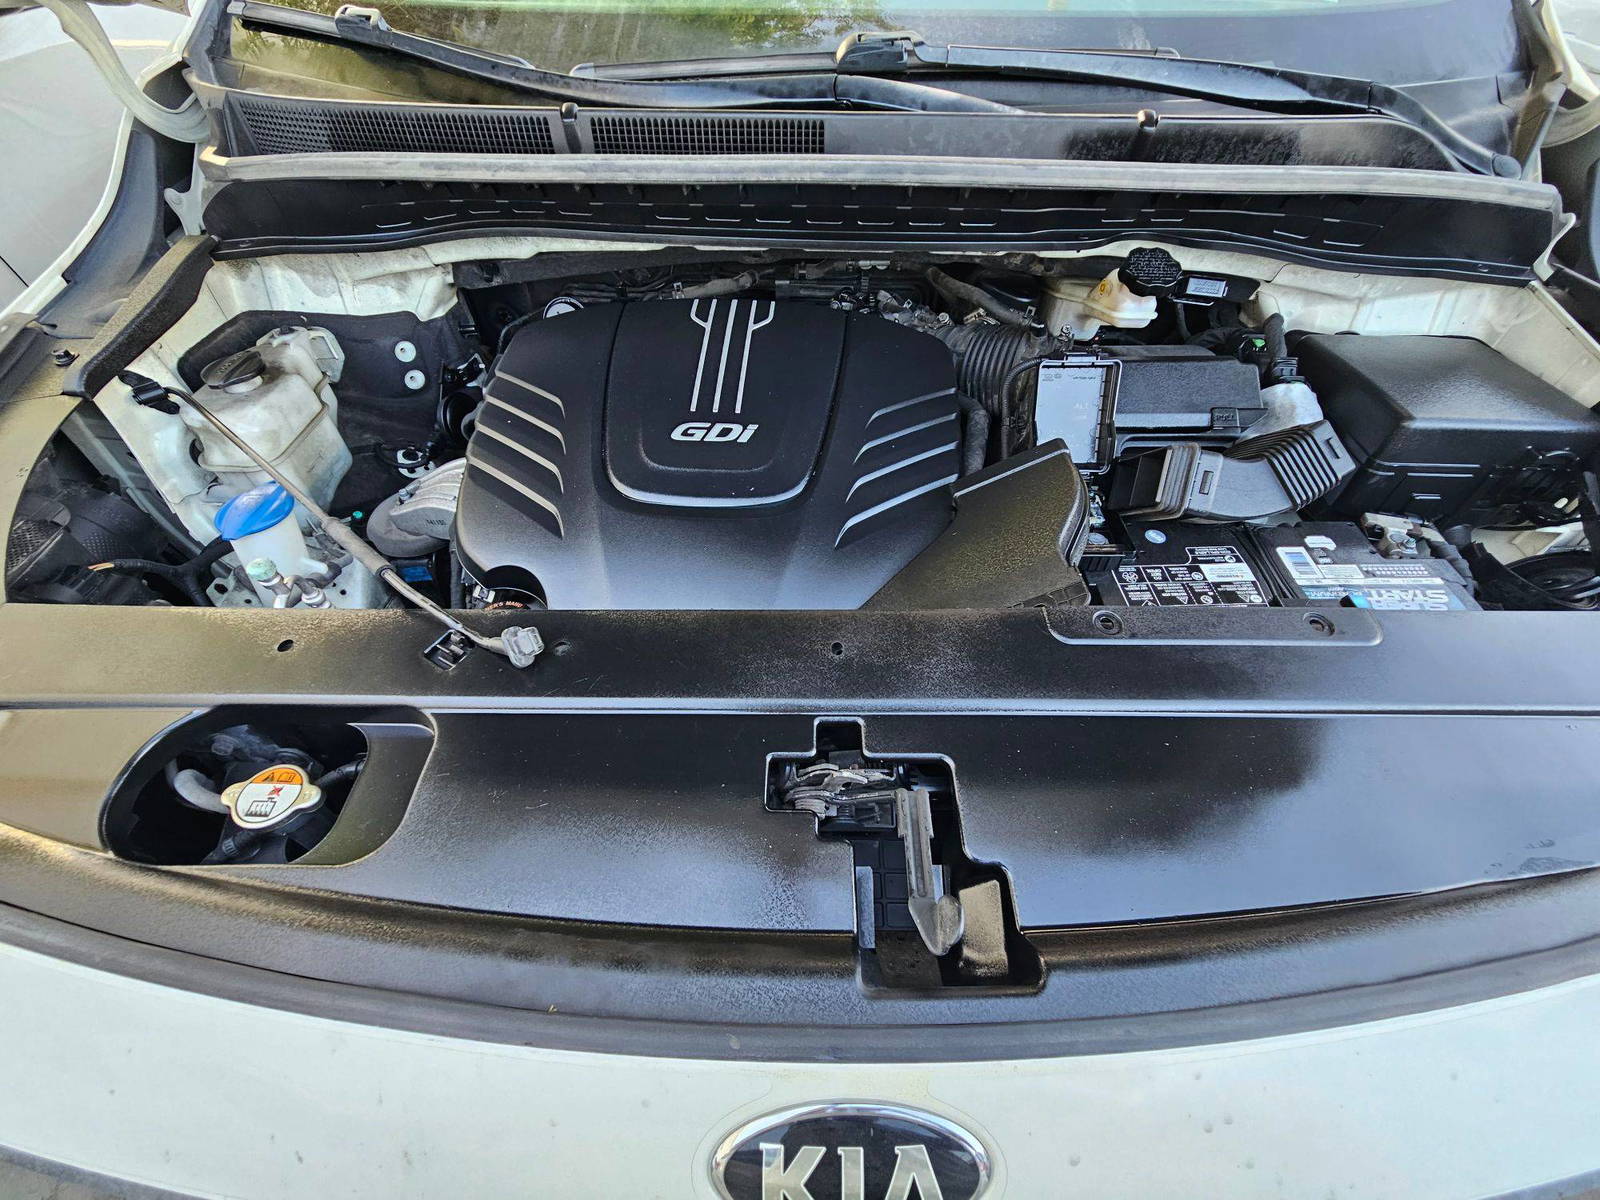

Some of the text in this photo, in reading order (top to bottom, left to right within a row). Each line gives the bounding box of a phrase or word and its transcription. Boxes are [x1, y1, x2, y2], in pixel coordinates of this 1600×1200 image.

[670, 422, 759, 443] GDi
[1366, 589, 1449, 603] START
[759, 1142, 944, 1200] KIA
